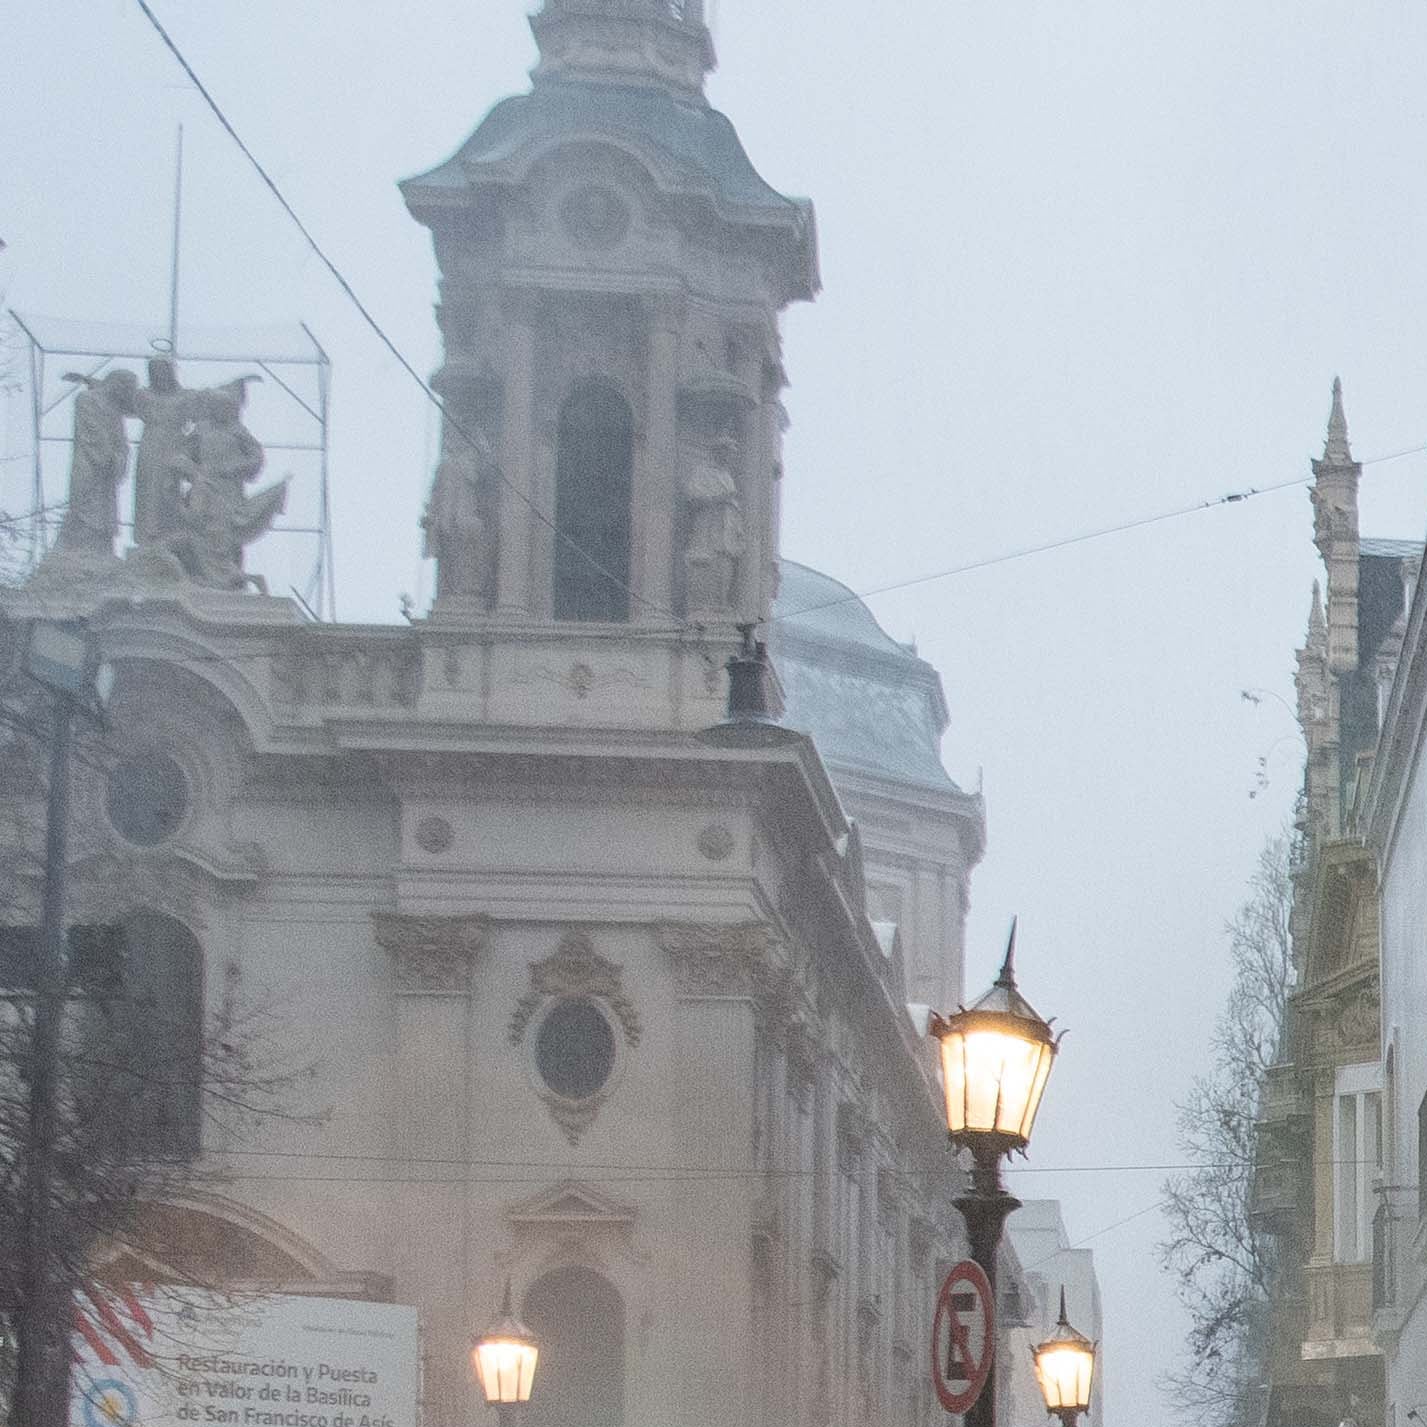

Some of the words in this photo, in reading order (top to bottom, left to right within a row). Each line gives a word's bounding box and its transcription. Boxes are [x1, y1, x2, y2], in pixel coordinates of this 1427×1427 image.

[178, 1353, 298, 1378] Restauración
[303, 1366, 314, 1384] y
[318, 1363, 378, 1384] Puesta
[177, 1381, 201, 1397] en
[205, 1380, 254, 1400] Valor
[258, 1383, 282, 1402] de
[286, 1385, 301, 1403] la
[306, 1387, 372, 1407] Basílica
[177, 1404, 201, 1422] de
[205, 1405, 239, 1423] San
[244, 1407, 328, 1427] Francisco
